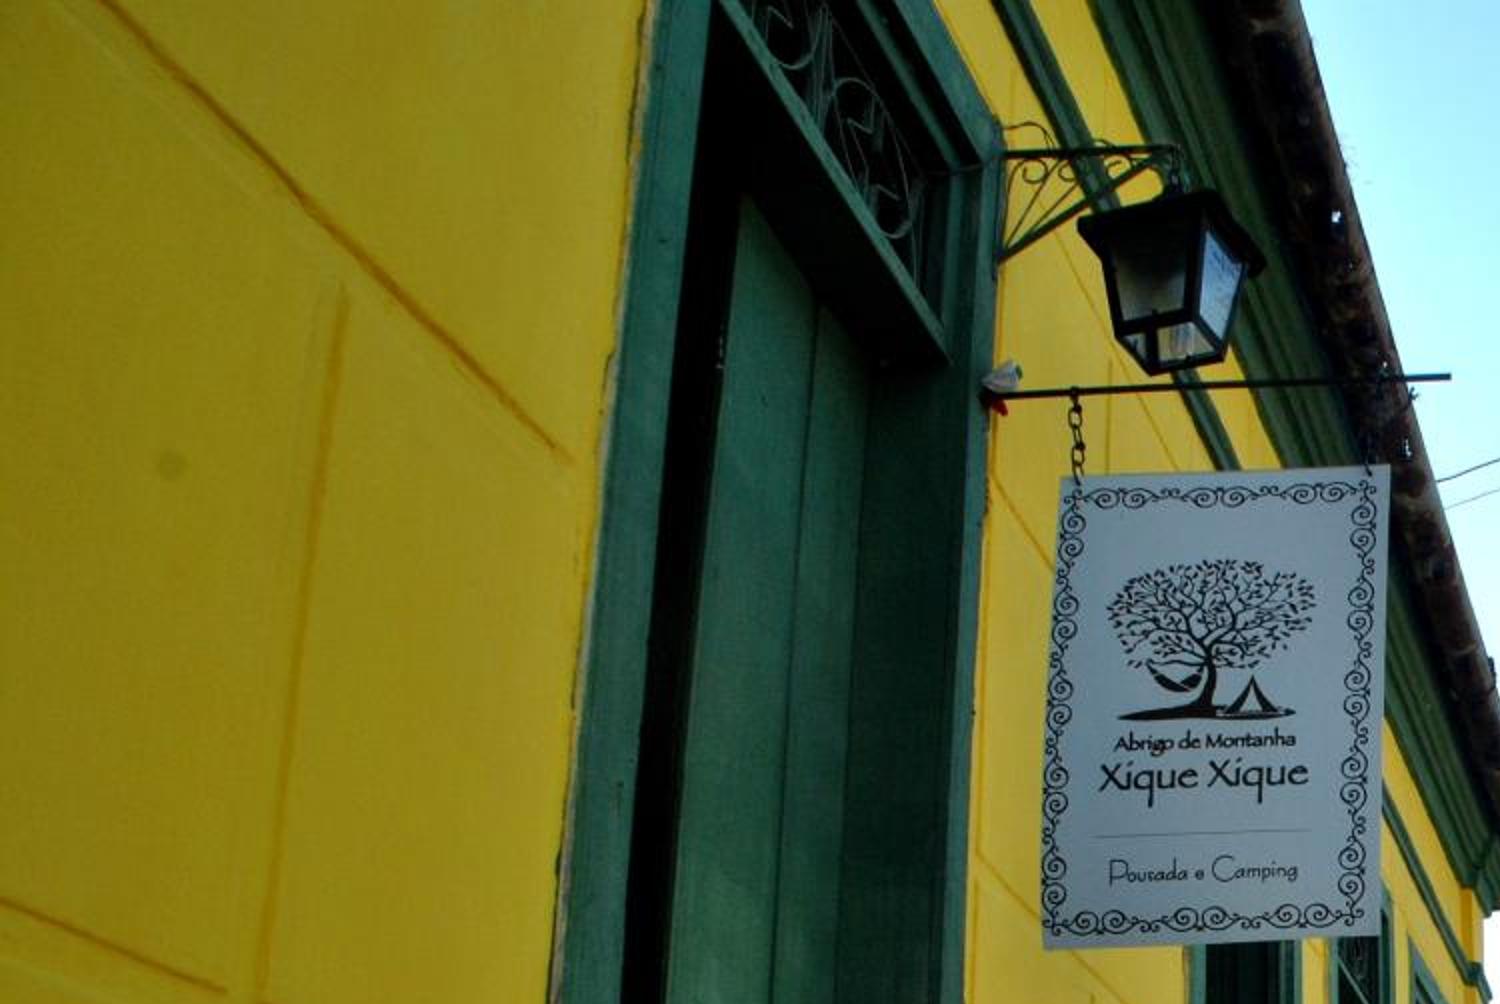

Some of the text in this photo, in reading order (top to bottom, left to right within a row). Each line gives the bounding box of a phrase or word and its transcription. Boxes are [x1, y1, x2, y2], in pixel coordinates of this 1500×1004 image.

[1114, 726, 1297, 757] Abrigo de Montanha
[1109, 855, 1298, 886] Pousada e Camping
